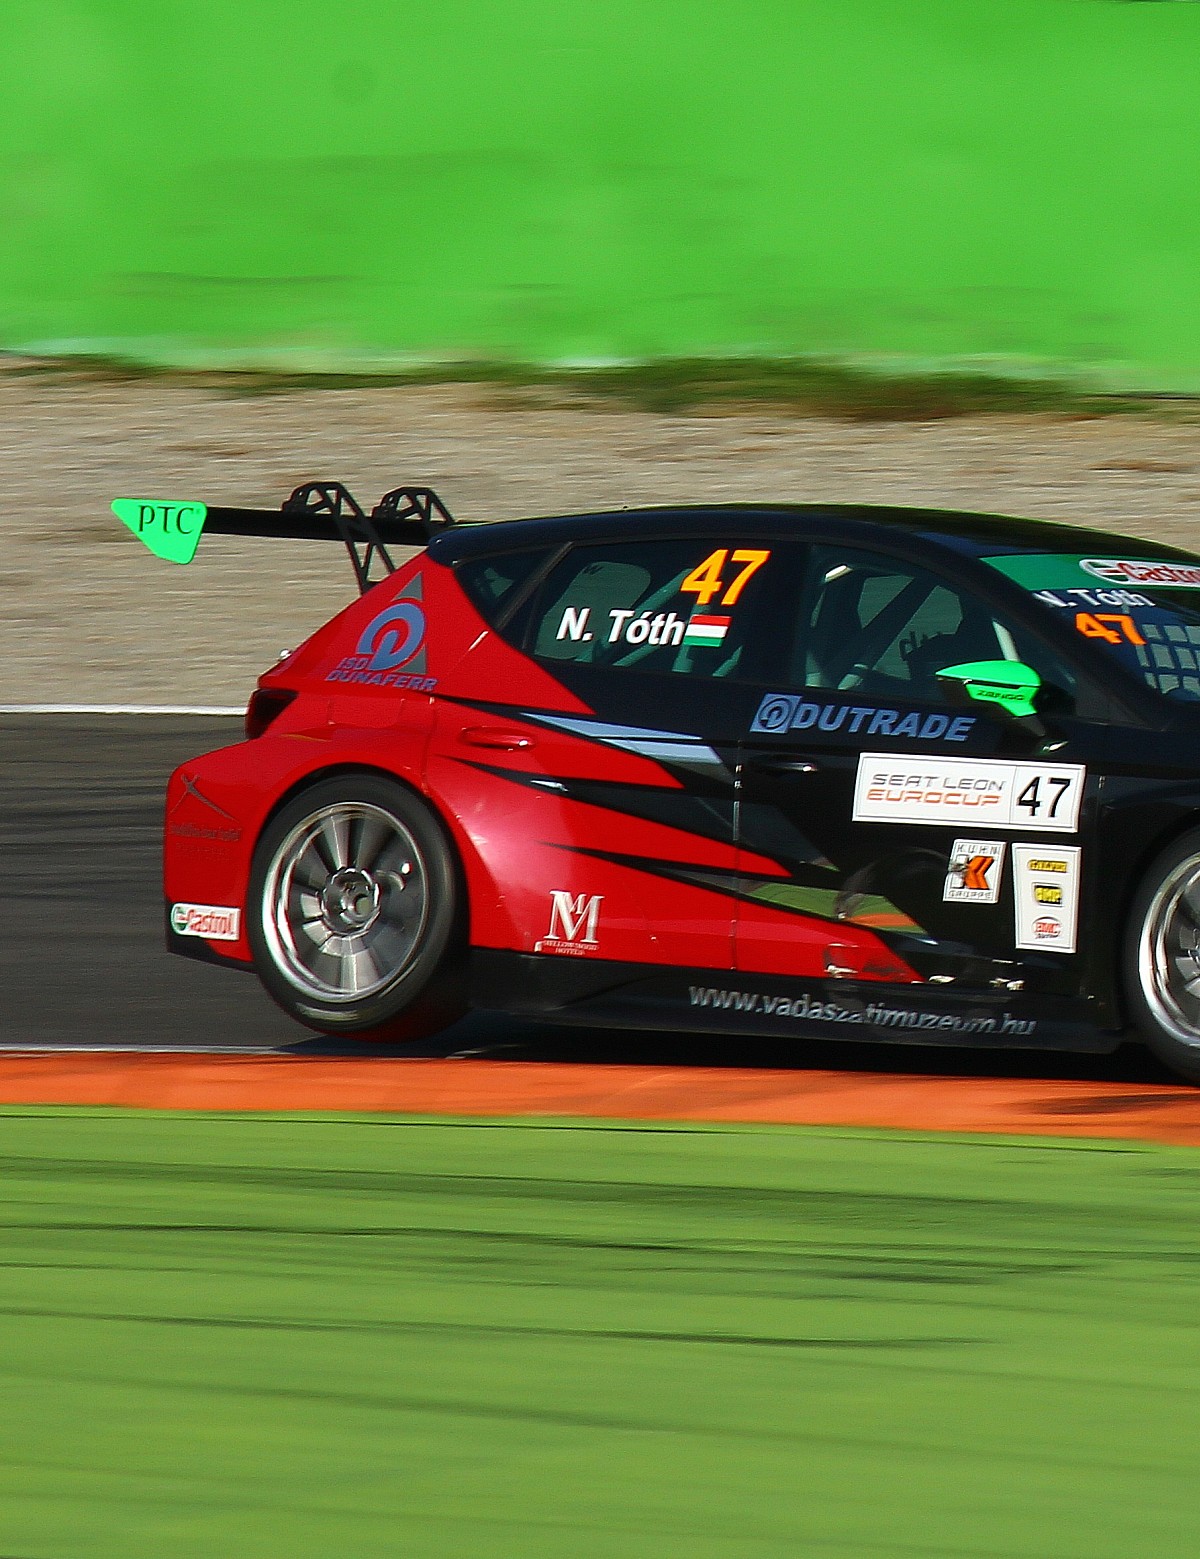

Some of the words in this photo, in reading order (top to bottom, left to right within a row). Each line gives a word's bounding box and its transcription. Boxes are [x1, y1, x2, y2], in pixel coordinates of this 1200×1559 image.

[138, 504, 196, 535] PTC
[680, 548, 770, 606] 47
[1066, 588, 1155, 608] Tóth
[556, 606, 593, 642] N.
[608, 609, 685, 646] Tóth
[1075, 611, 1147, 646] 47
[324, 669, 438, 692] DUNAFERR
[790, 701, 977, 741] DUTRADE
[870, 773, 940, 787] SEAT
[942, 777, 1007, 792] LEON
[1015, 775, 1072, 818] 47
[866, 788, 1004, 807] EUROCUP
[956, 844, 999, 855] KUHN
[187, 908, 234, 935] Castrol
